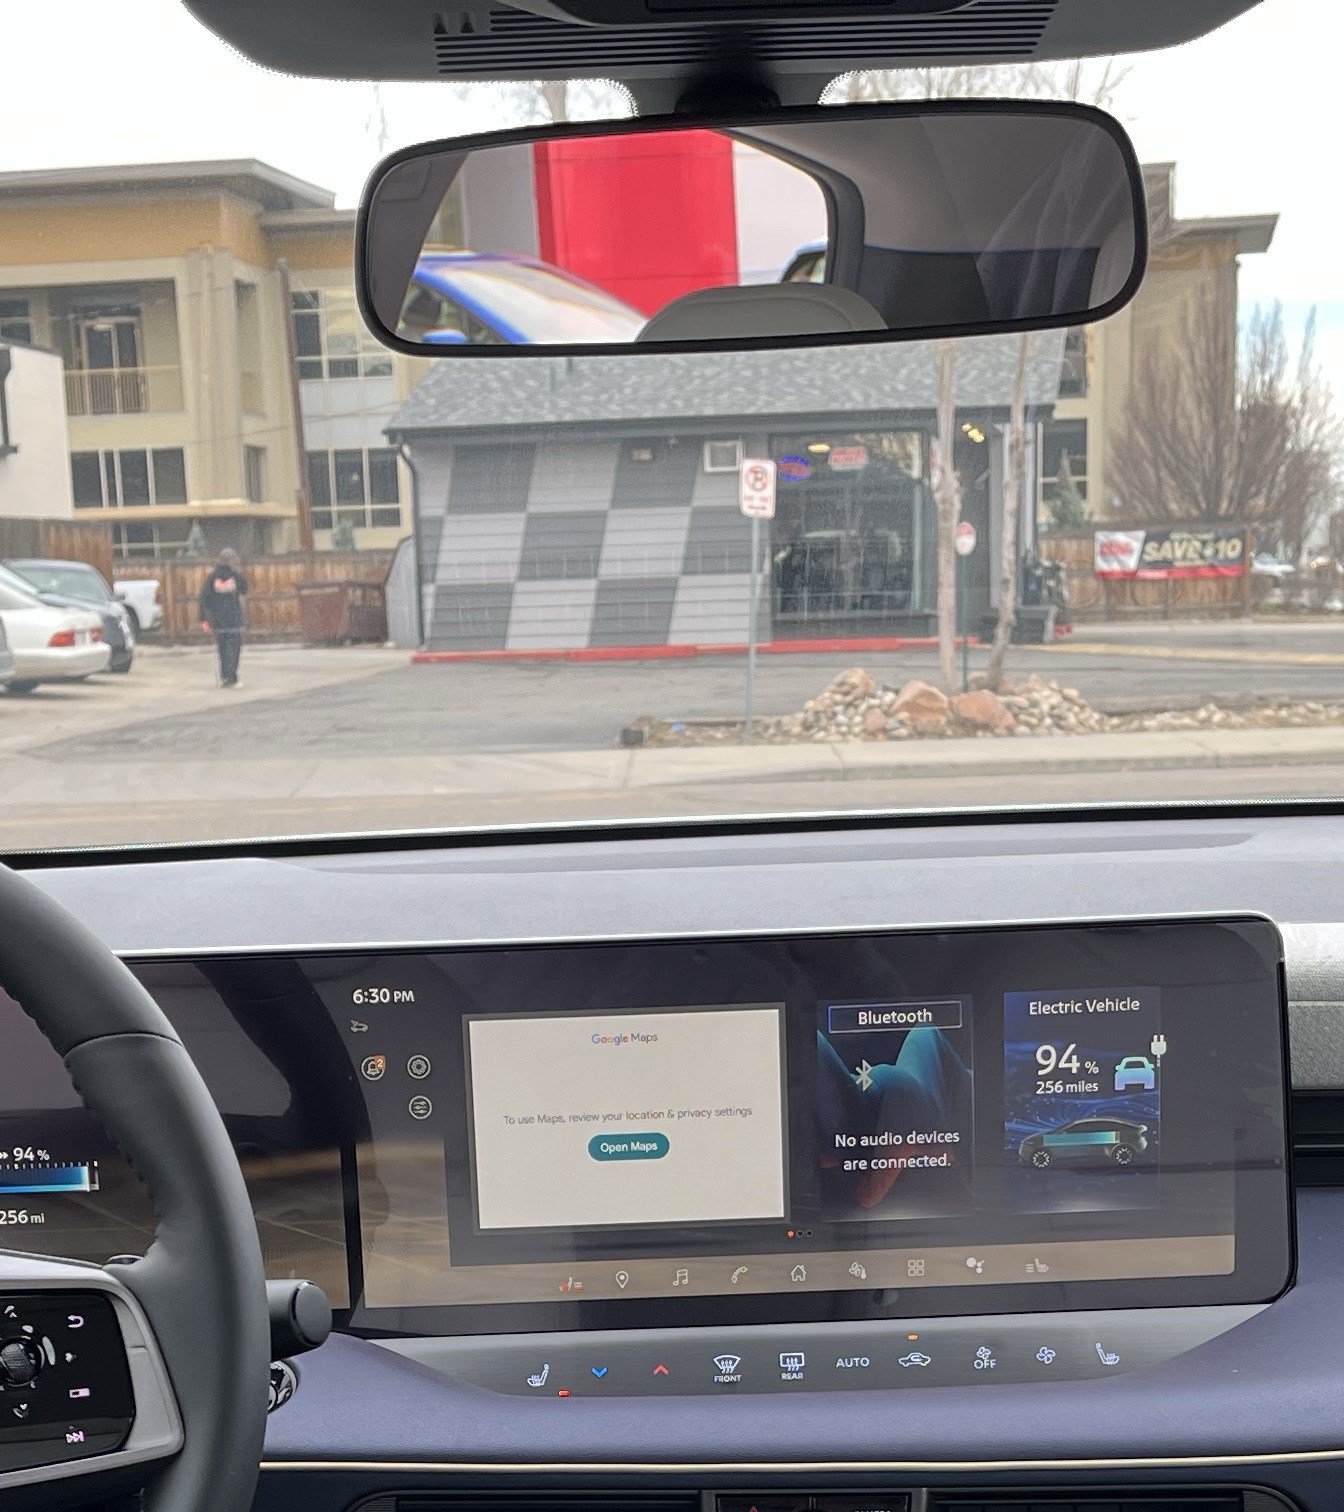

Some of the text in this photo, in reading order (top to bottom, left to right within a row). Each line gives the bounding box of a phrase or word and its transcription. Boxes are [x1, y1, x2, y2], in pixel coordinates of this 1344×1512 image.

[353, 988, 414, 1004] 6:30 PM
[1030, 997, 1139, 1015] Electric Vehicle
[859, 1008, 932, 1024] Bluetooth
[591, 1032, 658, 1046] Google Maps
[1036, 1044, 1099, 1075] 94 %
[1036, 1081, 1098, 1094] 256 miles
[503, 1105, 753, 1126] To use Maps, review your location & privacy settings
[836, 1131, 959, 1147] No audio devices
[13, 1147, 50, 1161] 94 %
[601, 1142, 658, 1154] Open Maps
[844, 1153, 951, 1170] are connected.
[30, 1213, 45, 1223] mi
[836, 1357, 869, 1368] AUTO
[973, 1359, 996, 1370] OFF
[714, 1373, 741, 1383] FRONT
